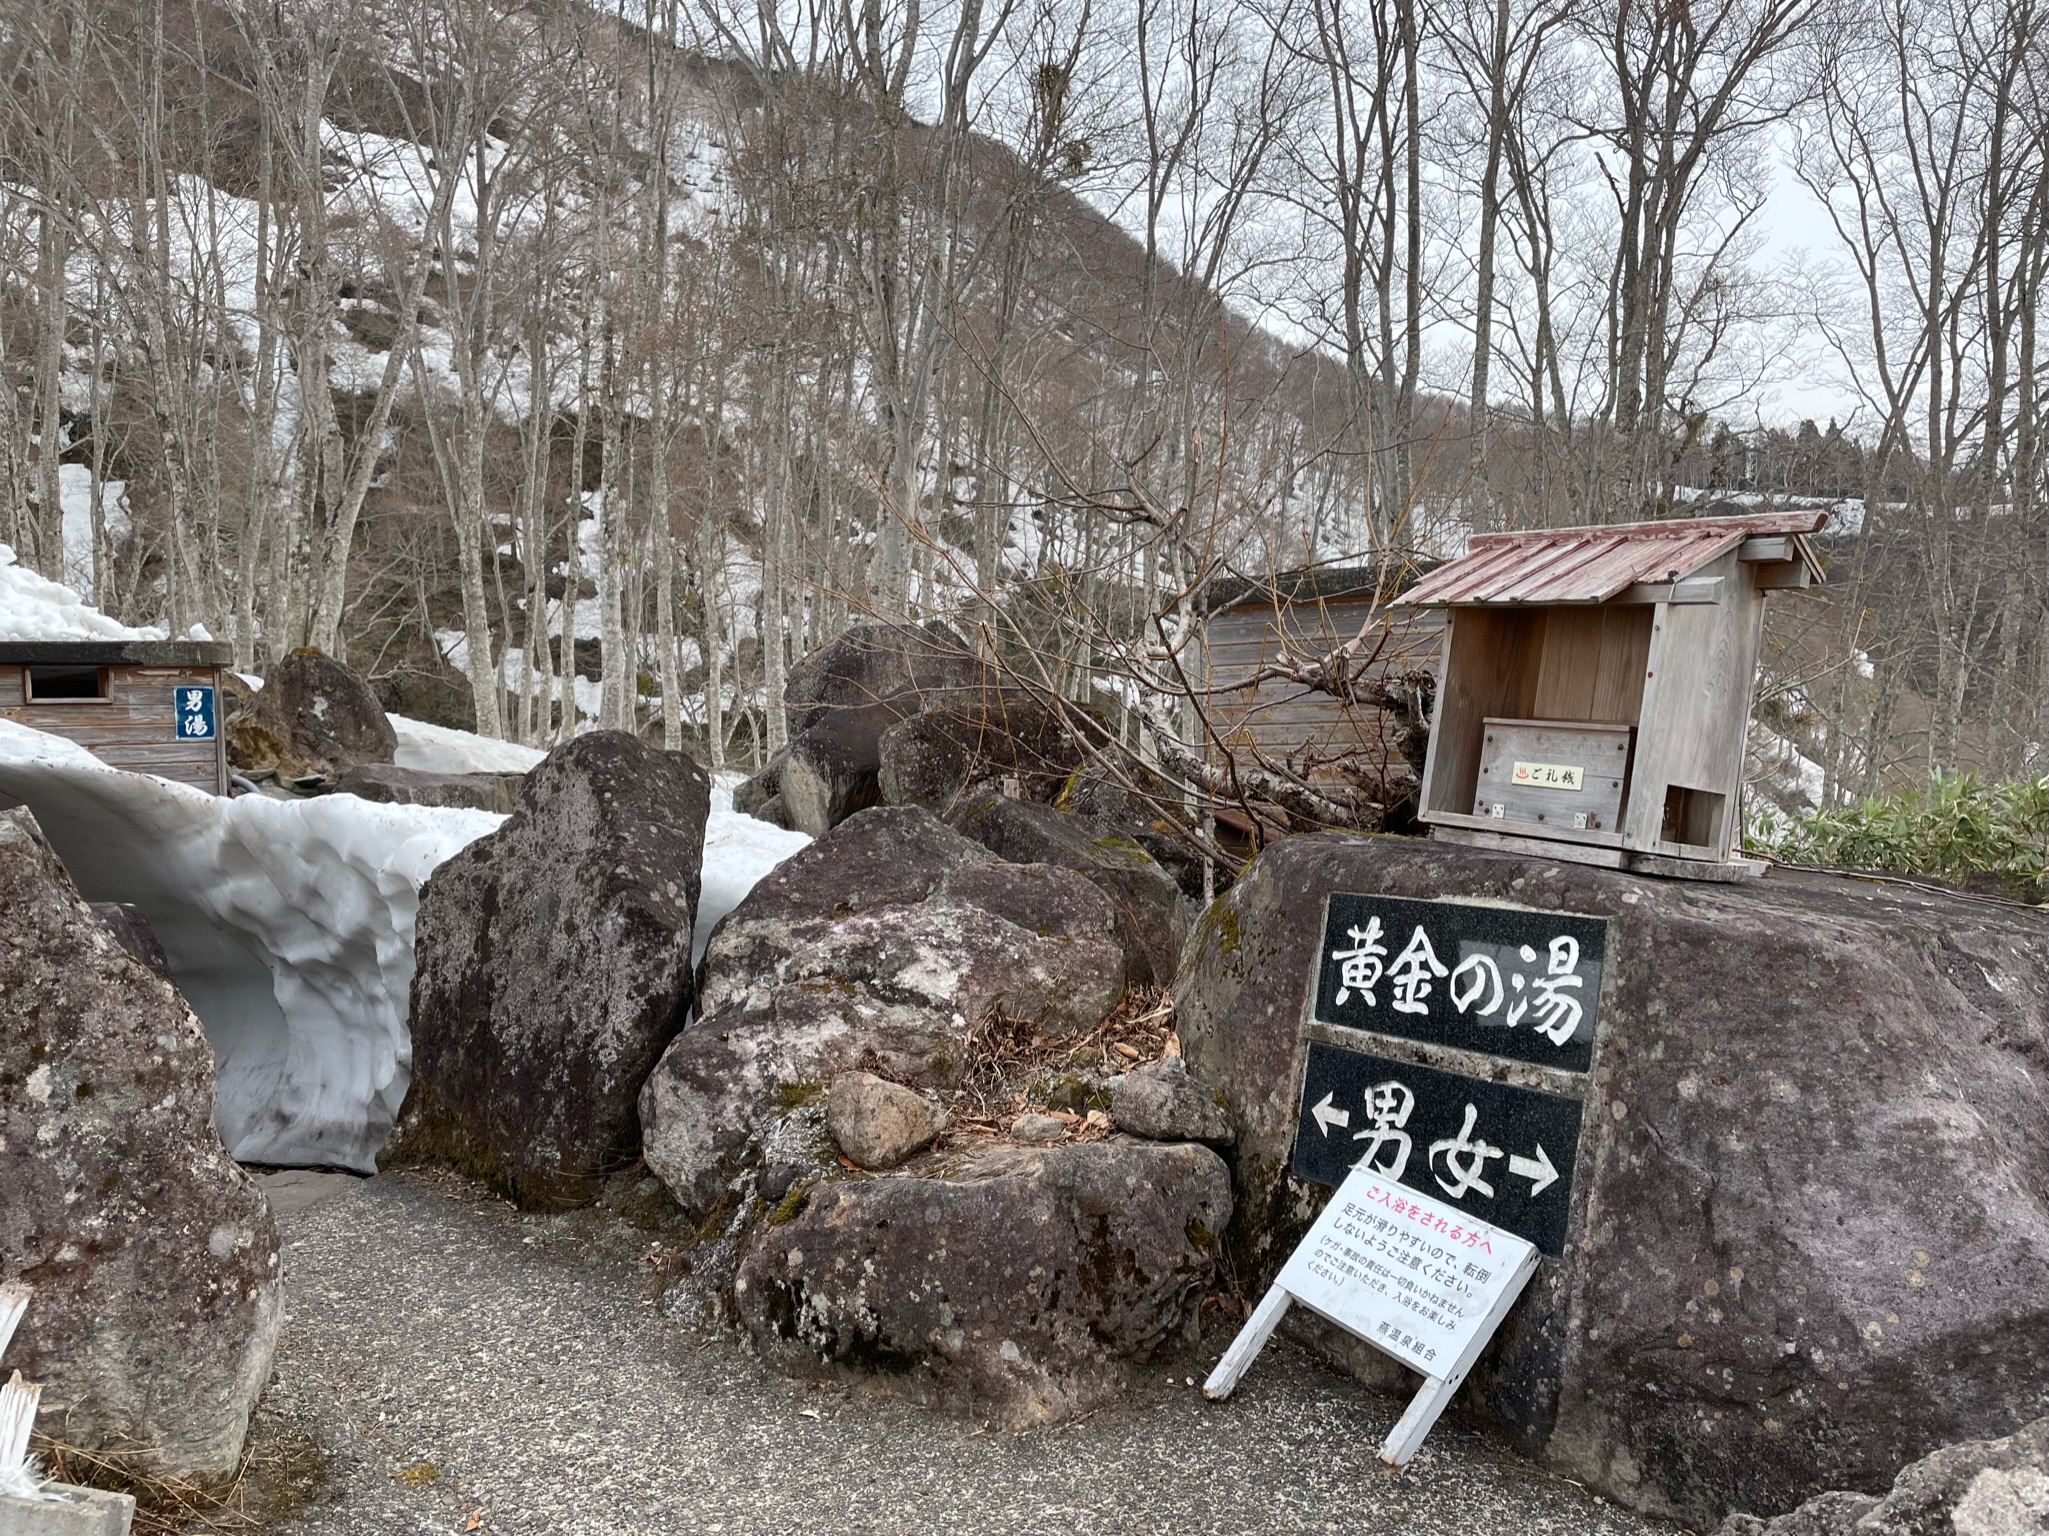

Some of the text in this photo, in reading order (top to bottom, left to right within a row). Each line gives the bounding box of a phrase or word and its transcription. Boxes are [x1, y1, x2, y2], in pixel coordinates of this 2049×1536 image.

[184, 689, 209, 737] 男湯
[1332, 915, 1584, 1047] 黄金の湯
[1348, 1080, 1505, 1199] 男 女
[1333, 1217, 1472, 1298] しないようご注意ください。
[1366, 1185, 1492, 1255] ご入浴をされる方へ
[1376, 1321, 1437, 1362] 燕温泉組合
